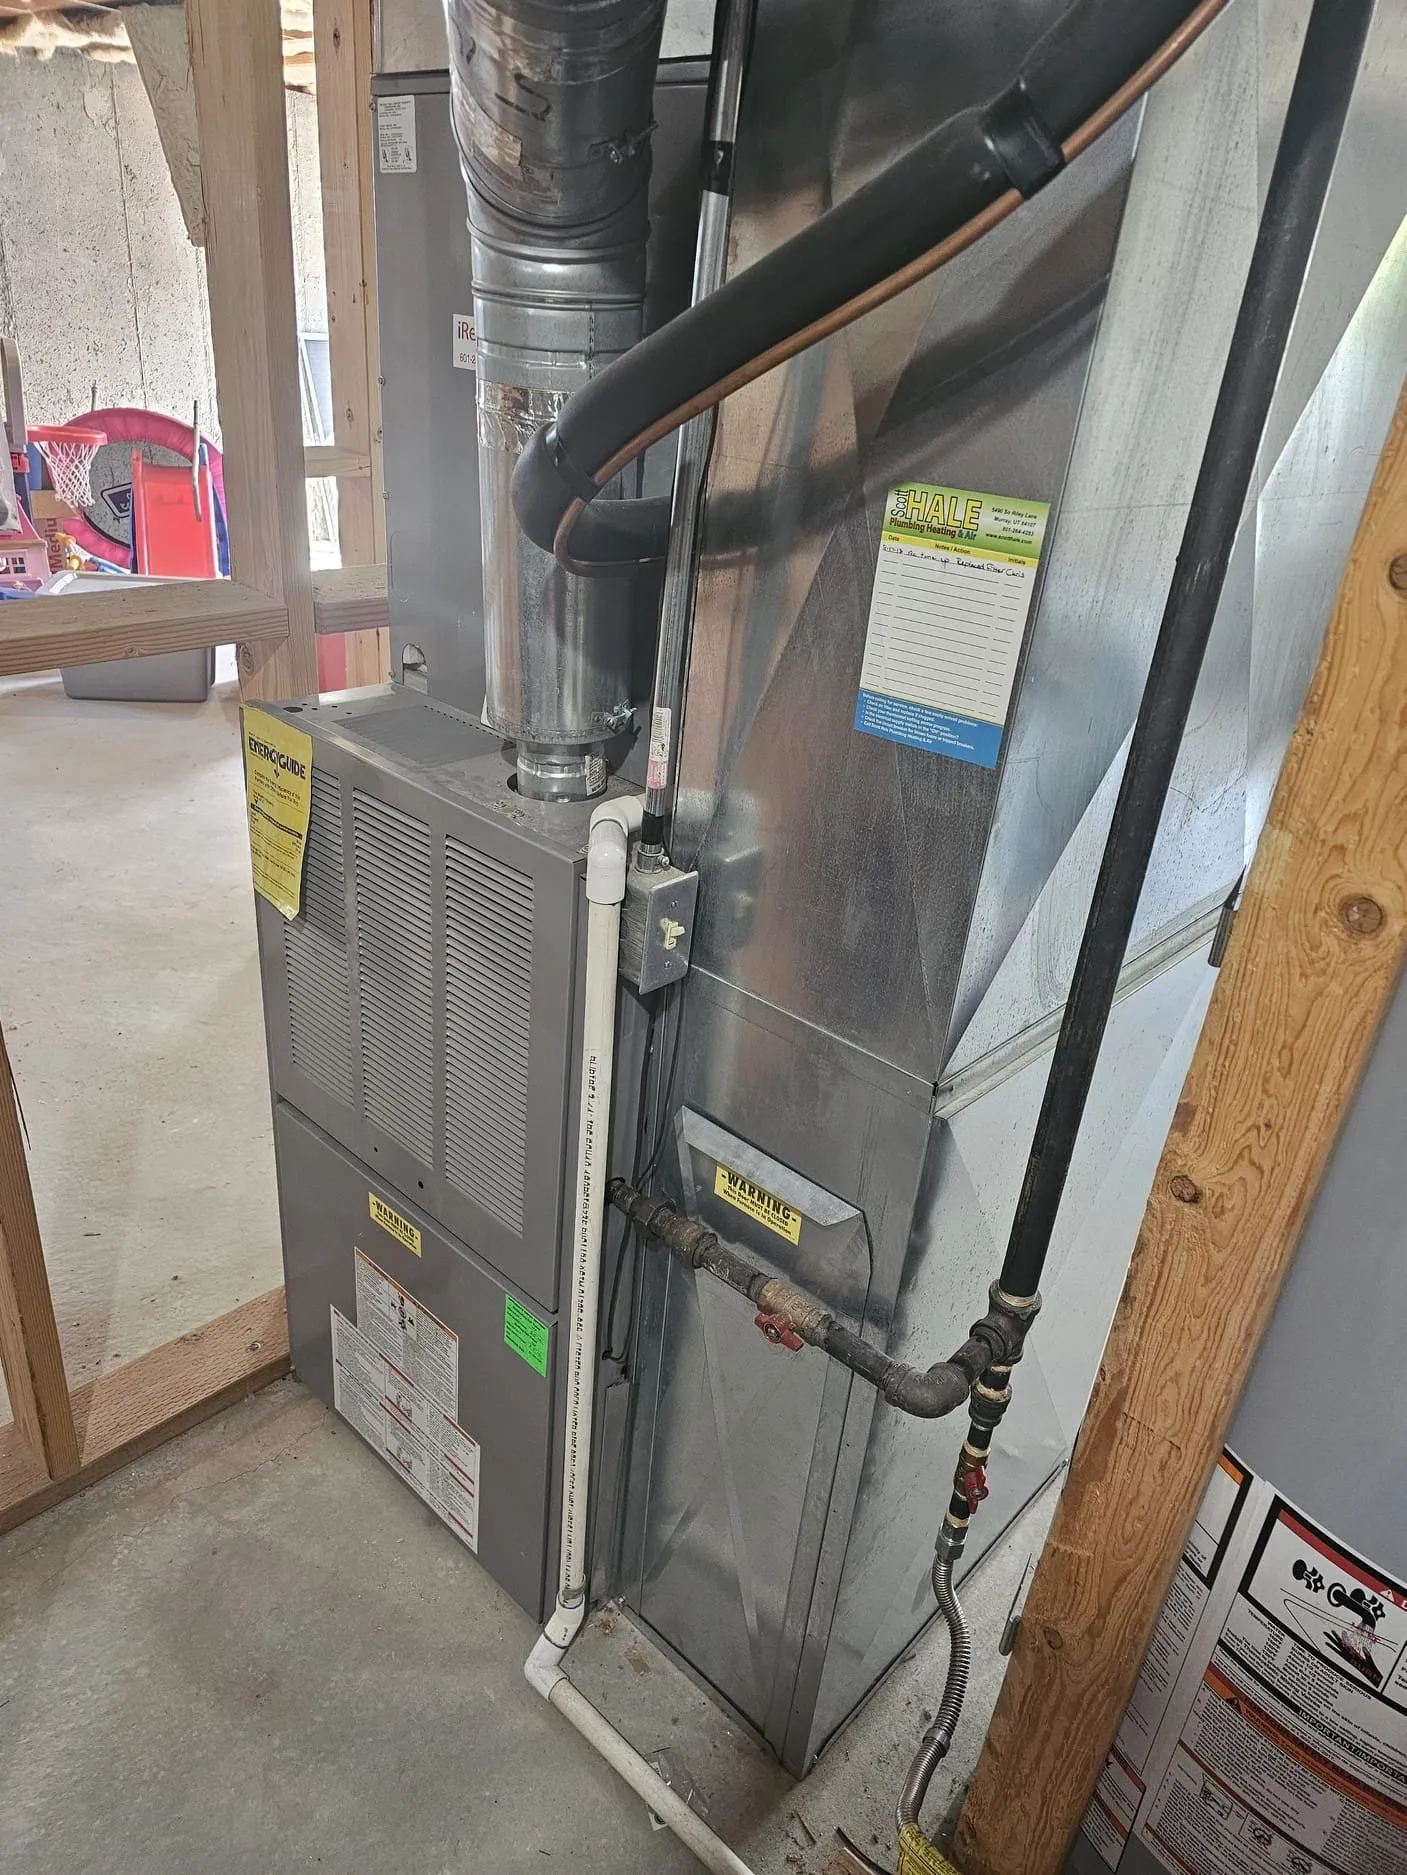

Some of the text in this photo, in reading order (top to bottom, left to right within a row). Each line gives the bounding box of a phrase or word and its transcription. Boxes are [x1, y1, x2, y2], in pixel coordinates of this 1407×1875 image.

[458, 321, 478, 346] iRe
[891, 489, 982, 530] Scott HALE
[889, 518, 977, 541] Plumbing Heating & Air
[953, 546, 970, 554] Action
[738, 1192, 749, 1201] Door
[750, 1199, 763, 1210] MUST
[771, 1212, 789, 1226] CLOSED
[1266, 1621, 1285, 1637] WATER
